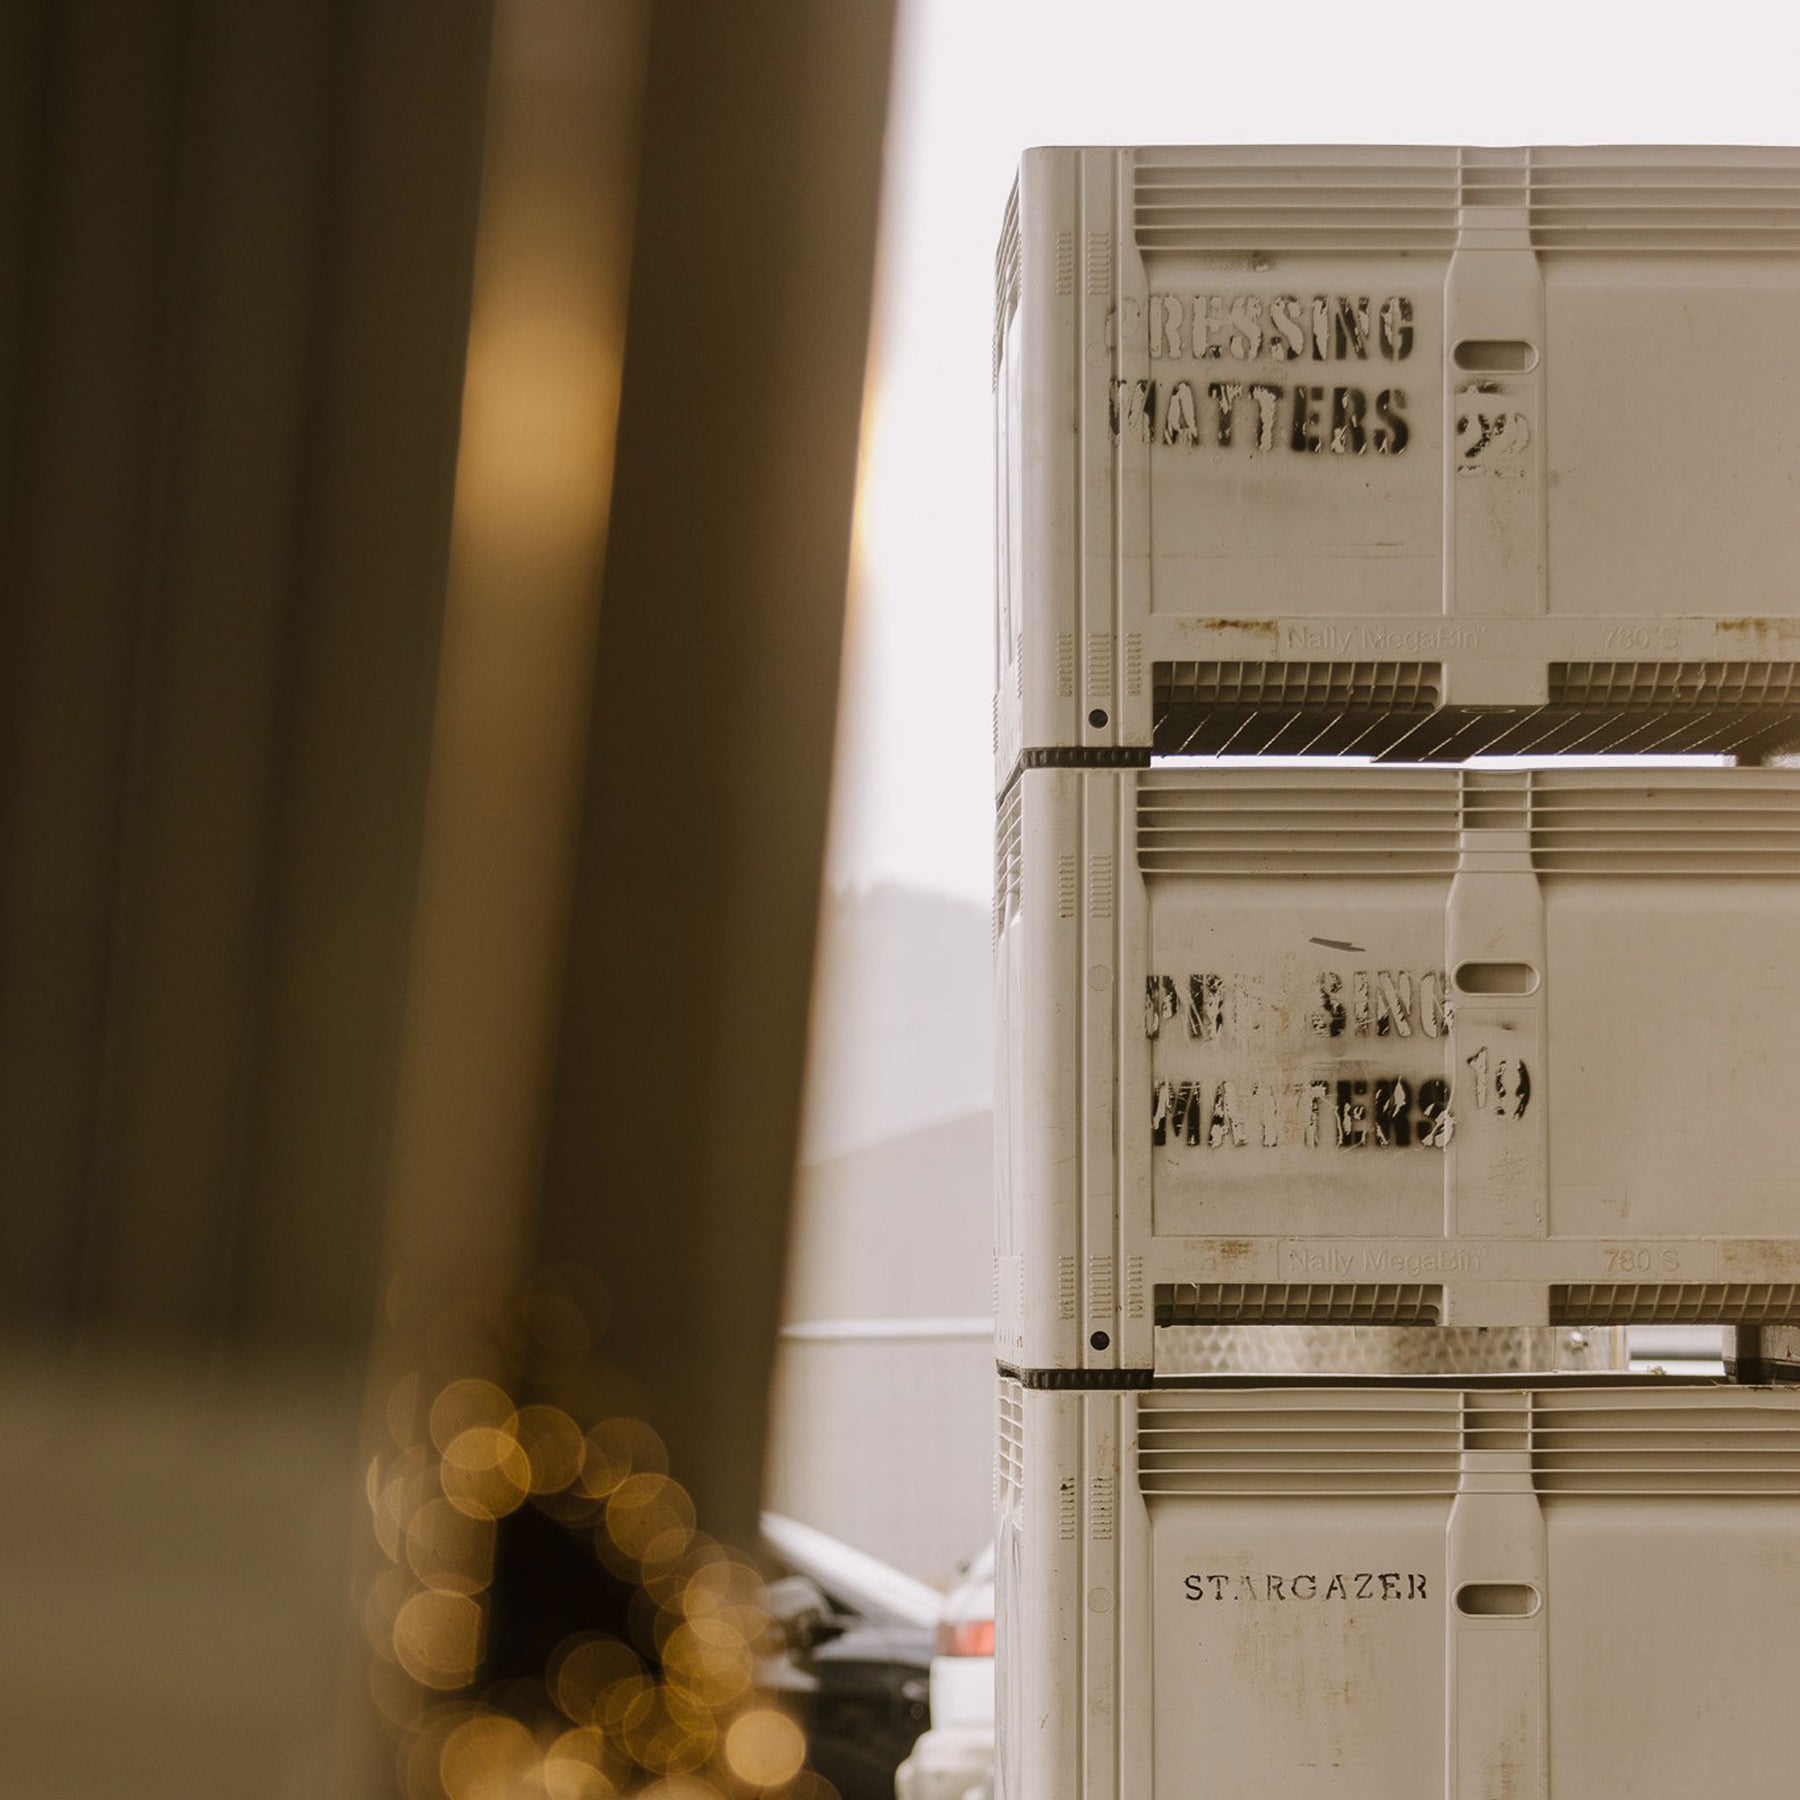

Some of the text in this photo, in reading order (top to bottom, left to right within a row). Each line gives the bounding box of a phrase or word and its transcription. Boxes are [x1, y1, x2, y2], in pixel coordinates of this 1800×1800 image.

[1108, 380, 1409, 455] MATTERS
[1288, 1248, 1353, 1275] Nally
[1184, 1573, 1427, 1601] STARGAZER
